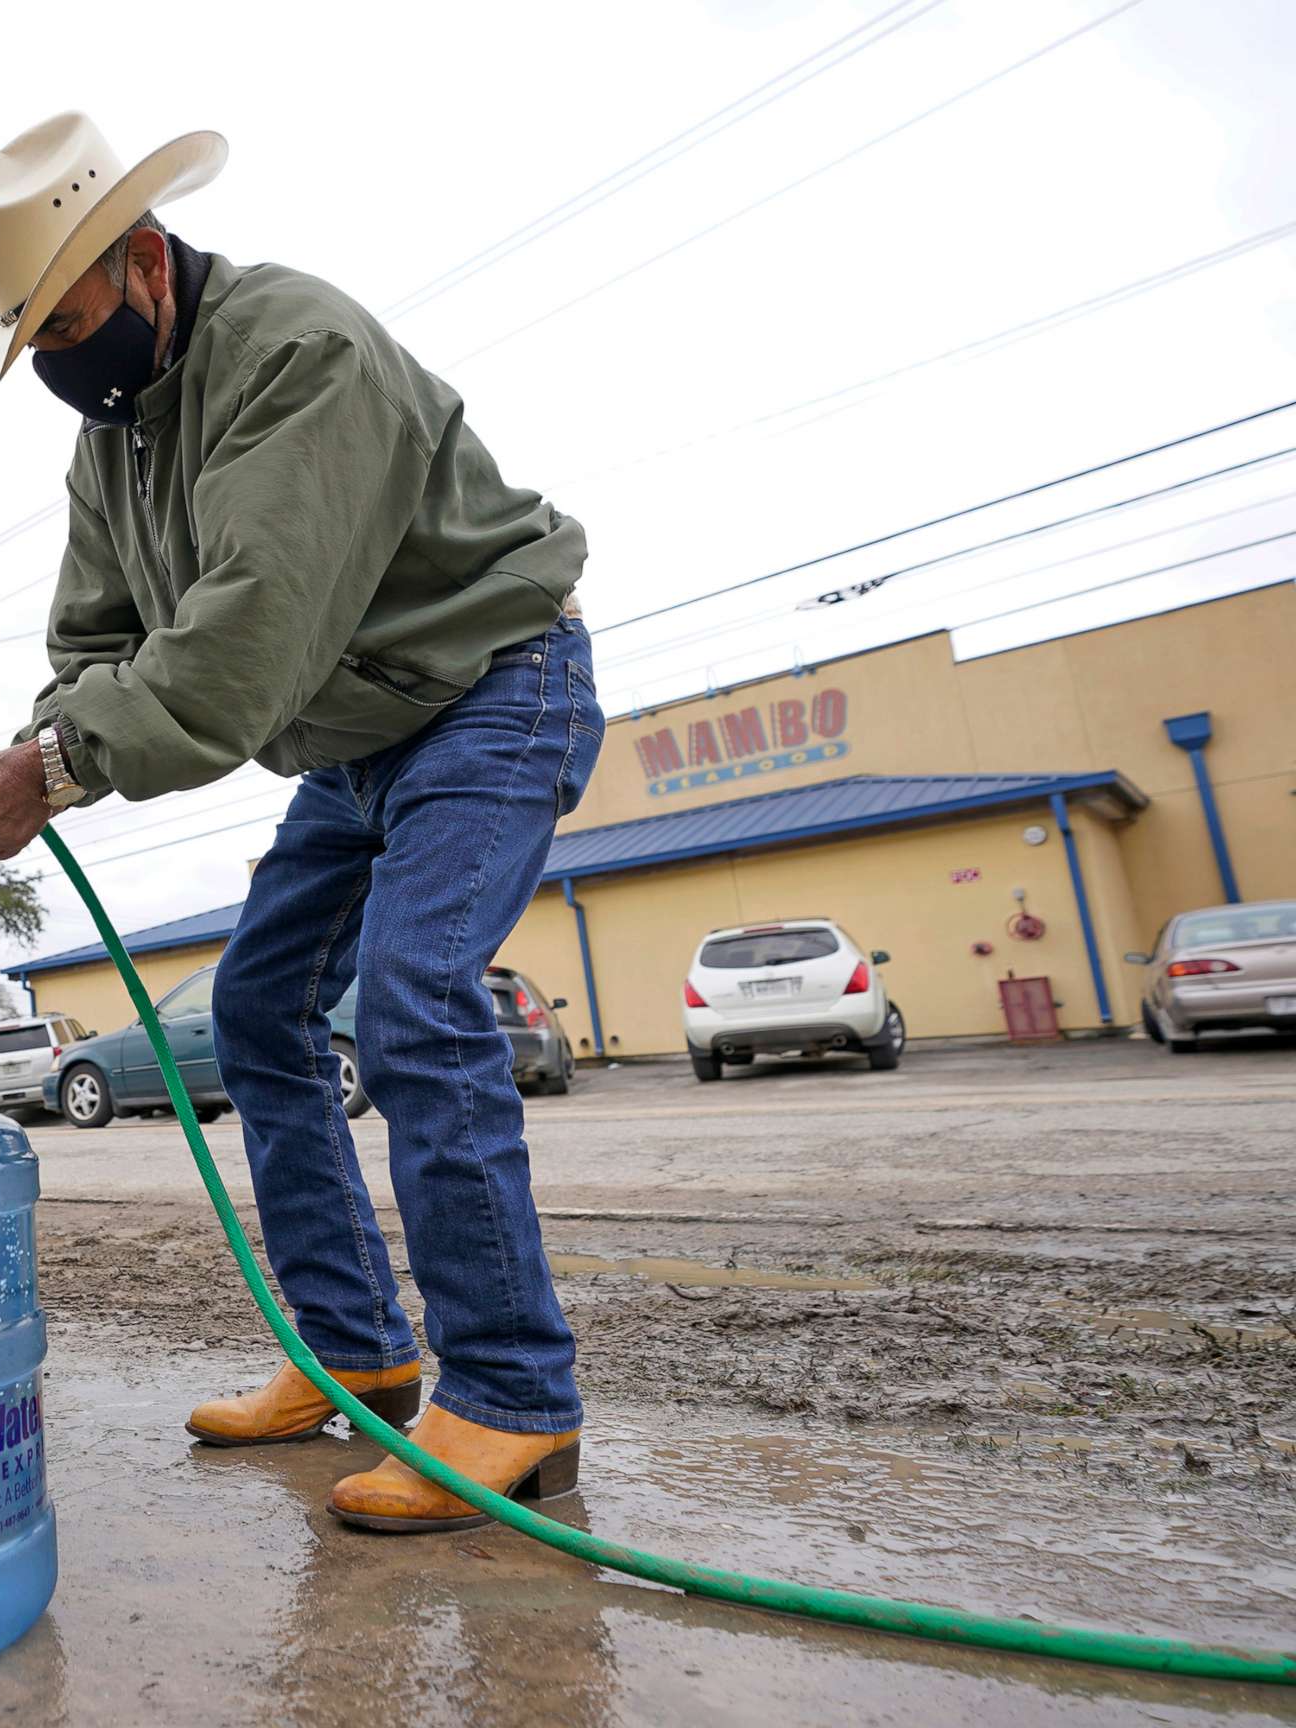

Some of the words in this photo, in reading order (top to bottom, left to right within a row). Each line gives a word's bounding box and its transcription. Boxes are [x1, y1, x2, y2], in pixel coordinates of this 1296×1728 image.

[634, 688, 847, 778] MAMBO
[655, 742, 840, 794] SEAFOOD
[2, 1439, 44, 1480] EXPR
[5, 1487, 13, 1507] A
